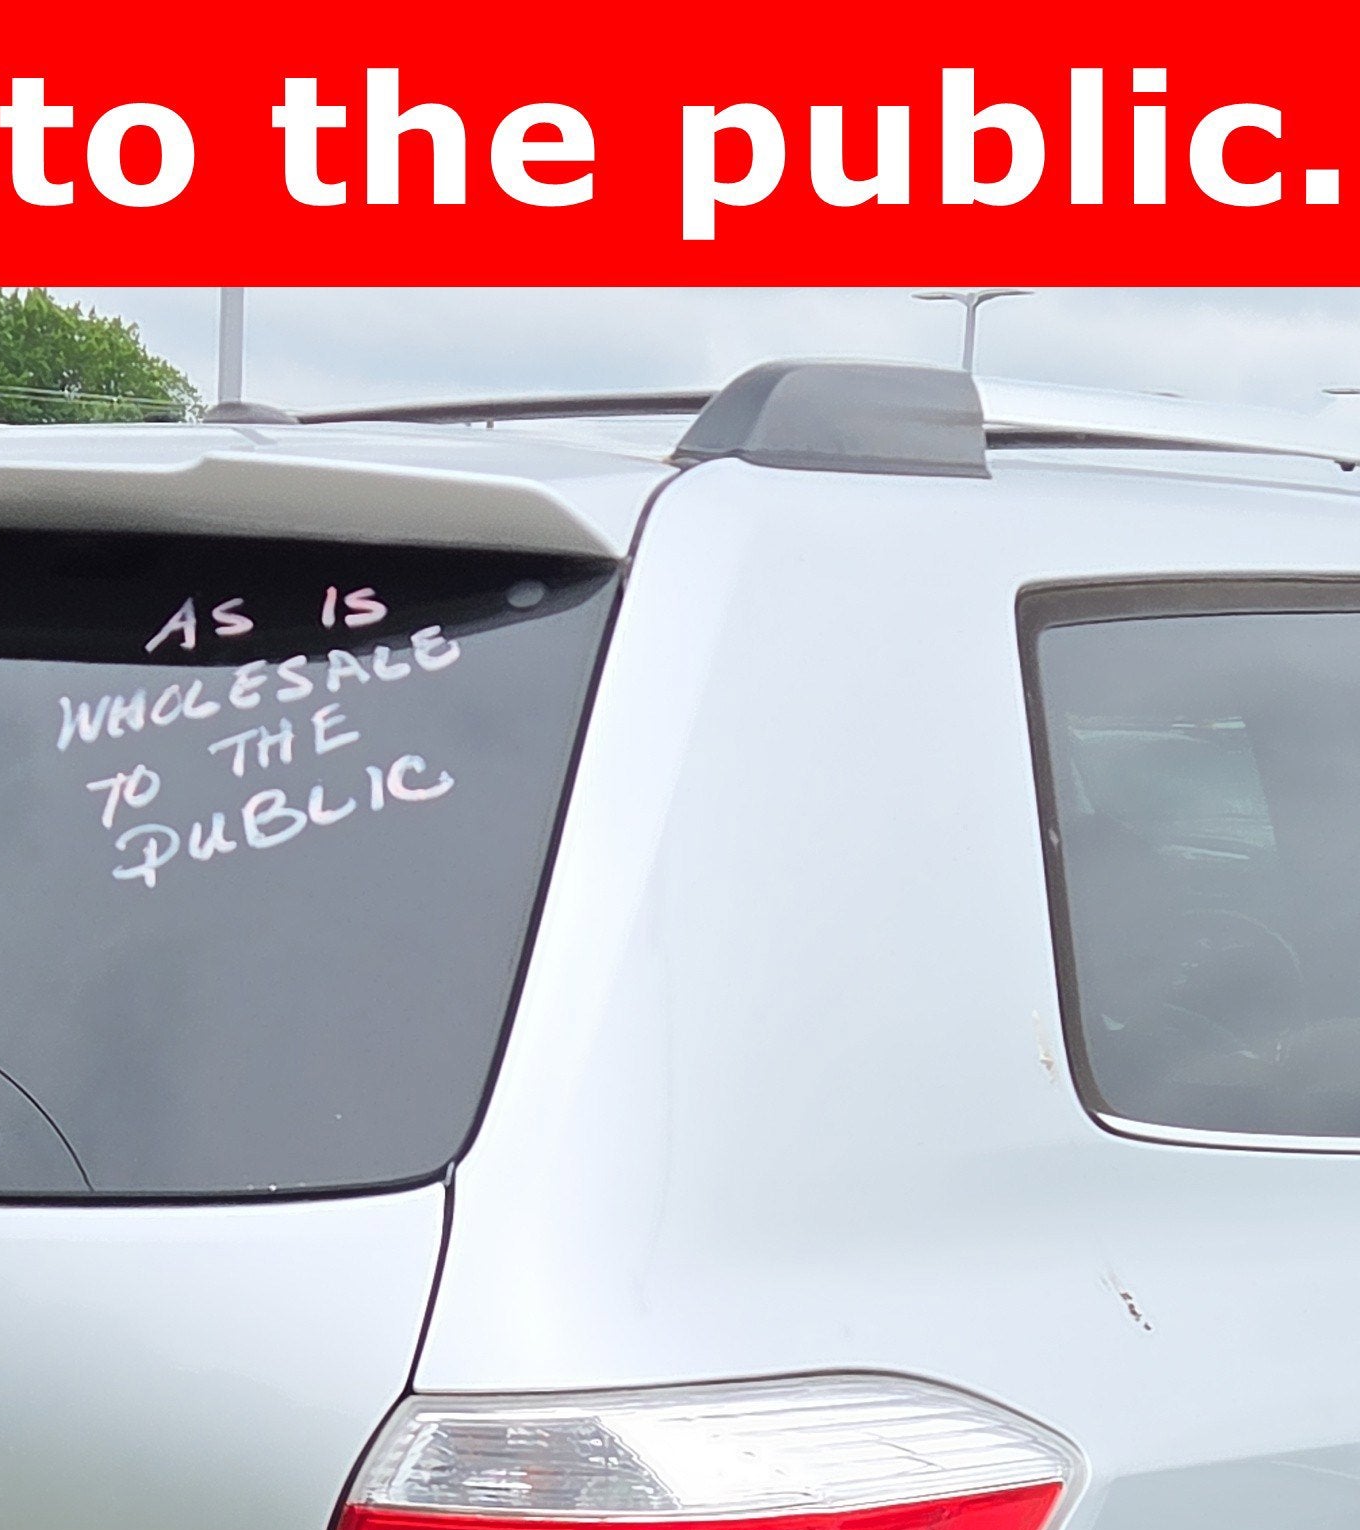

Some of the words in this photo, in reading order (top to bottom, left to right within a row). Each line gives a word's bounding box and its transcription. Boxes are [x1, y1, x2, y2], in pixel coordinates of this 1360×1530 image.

[145, 597, 253, 654] AS
[323, 586, 387, 629] IS
[58, 625, 461, 752] WHOLESALE
[86, 764, 160, 829] TO
[208, 703, 360, 778] THE
[112, 755, 455, 888] PUBLIC
